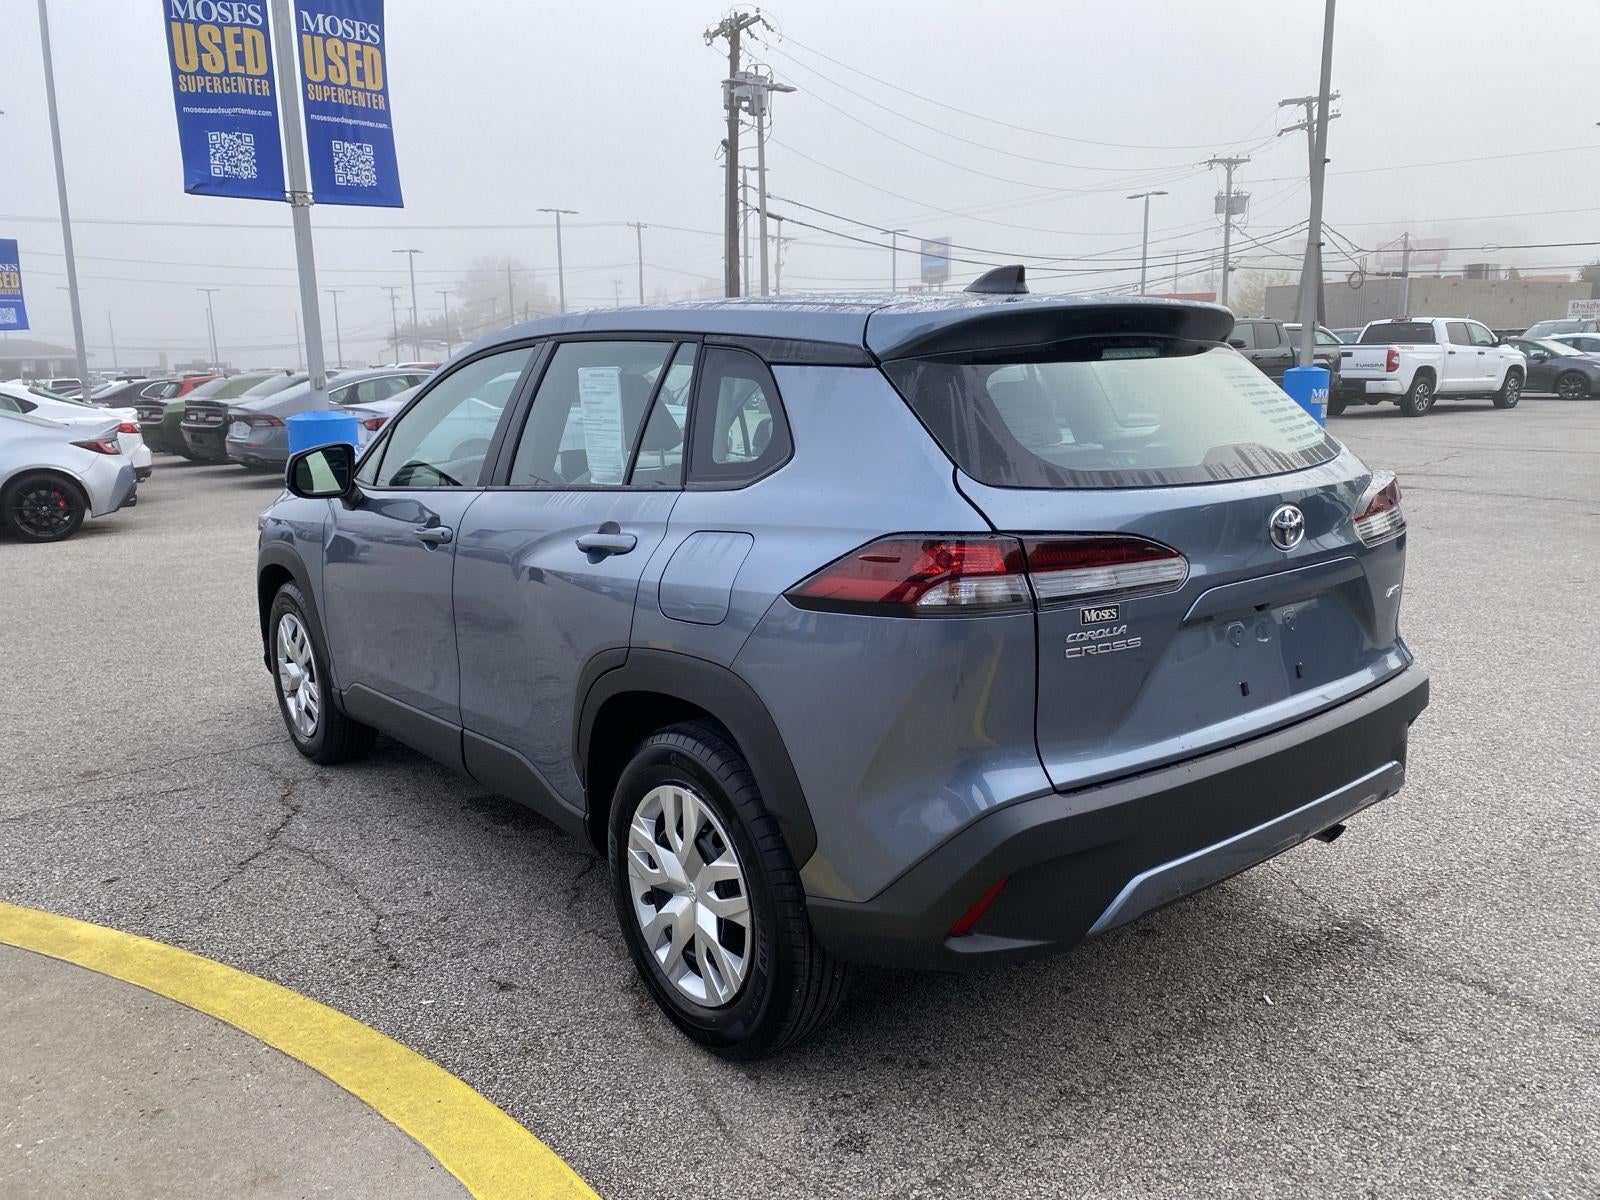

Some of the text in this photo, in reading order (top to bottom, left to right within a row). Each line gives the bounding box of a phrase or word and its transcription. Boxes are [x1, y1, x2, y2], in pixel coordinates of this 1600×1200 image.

[170, 0, 263, 26] MOSES
[300, 10, 380, 45] MOSES
[171, 21, 268, 76] USED
[302, 34, 383, 91] USED
[178, 74, 271, 97] SUPERCENTER
[307, 83, 386, 110] SUPERCENTER
[182, 105, 273, 117] mosesusedsupercenter.com
[311, 114, 388, 128] mosesusedsupercenter.com
[1084, 609, 1117, 622] MOSES
[1065, 624, 1128, 643] COROLLA
[1065, 637, 1142, 659] CROSS
